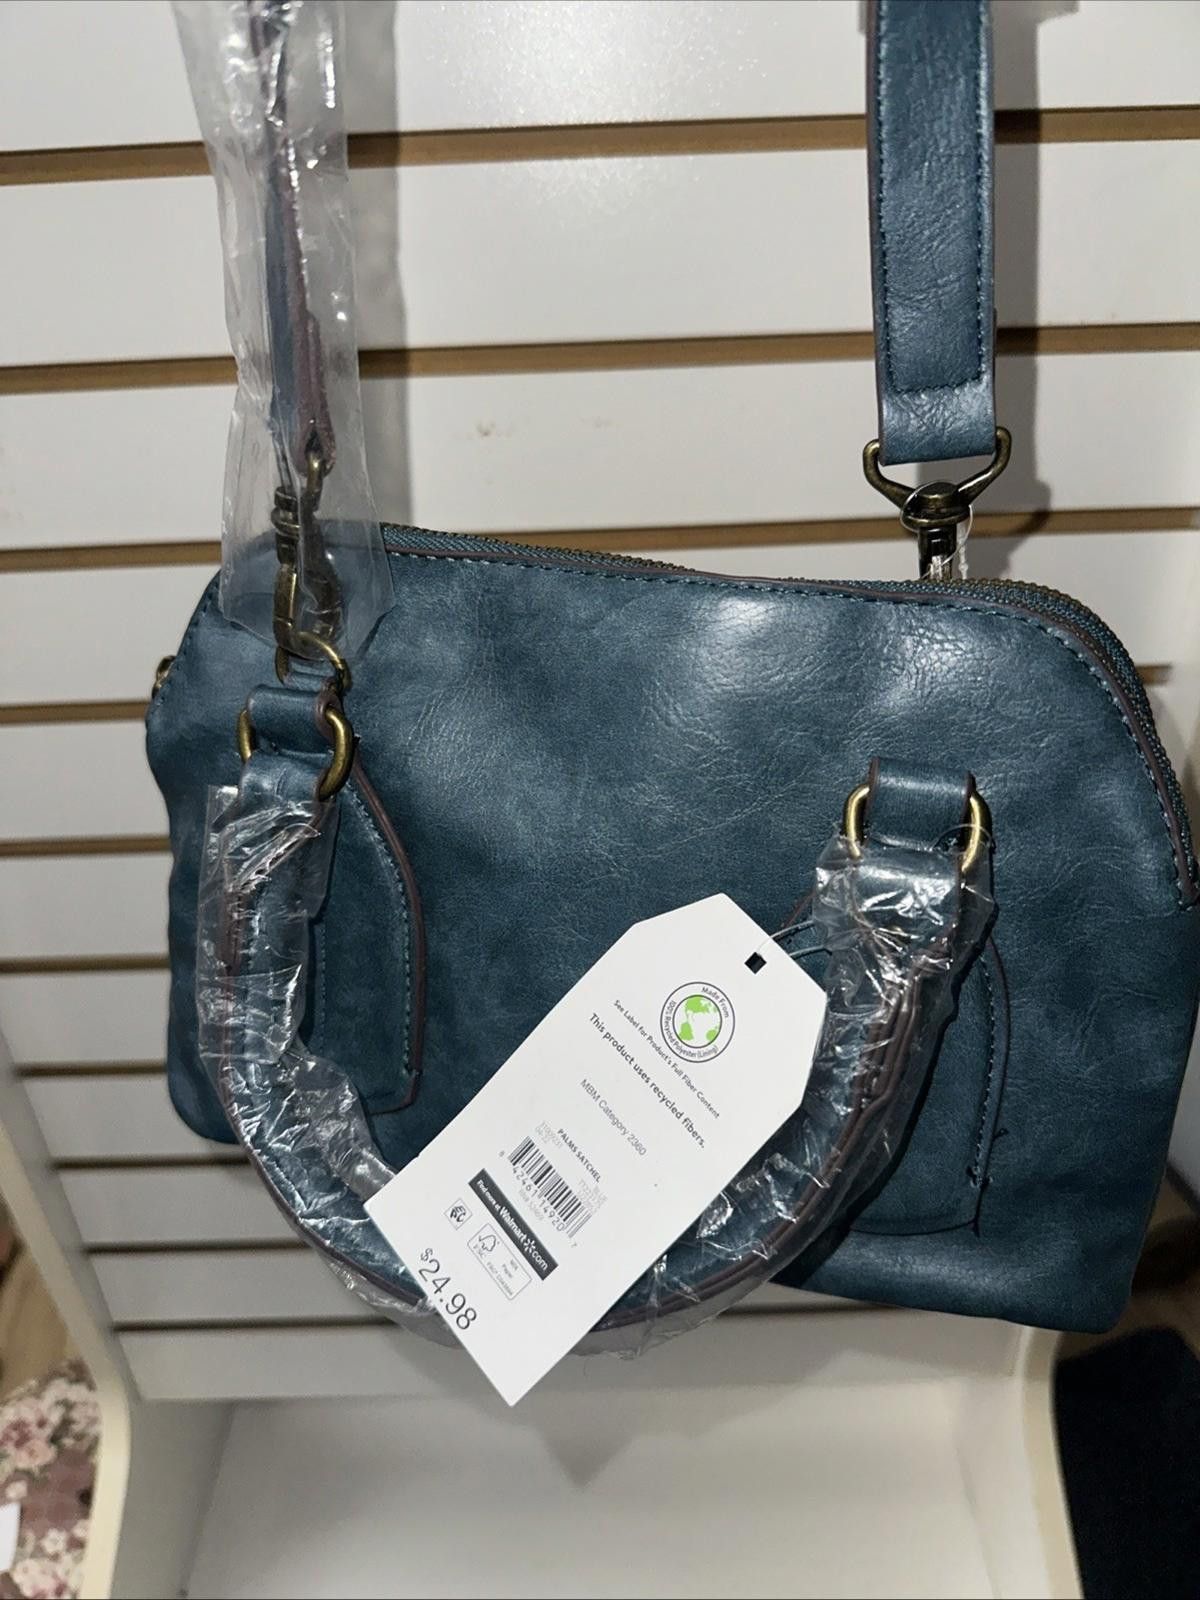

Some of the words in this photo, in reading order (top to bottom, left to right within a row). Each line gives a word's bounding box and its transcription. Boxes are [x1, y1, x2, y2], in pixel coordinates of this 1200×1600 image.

[701, 986, 720, 1000] Made
[718, 998, 730, 1018] From
[589, 1012, 606, 1033] This
[602, 1031, 635, 1065] product
[633, 1063, 651, 1084] uses
[649, 1082, 685, 1120] recycled
[681, 1117, 705, 1149] fibers.
[613, 999, 625, 1012] See
[623, 1010, 640, 1028] Label
[638, 1026, 648, 1037] for
[646, 1035, 673, 1066] Product's
[671, 1062, 684, 1077] Full
[682, 1074, 698, 1093] Fiber
[696, 1091, 720, 1119] Content
[580, 1079, 601, 1102] MBM
[598, 1100, 630, 1136] Category
[557, 1128, 578, 1153] PALMS
[575, 1150, 601, 1183] SATCHEL
[512, 1165, 539, 1198] 42461
[539, 1199, 565, 1232] 14920
[418, 1247, 477, 1330] $24.98
